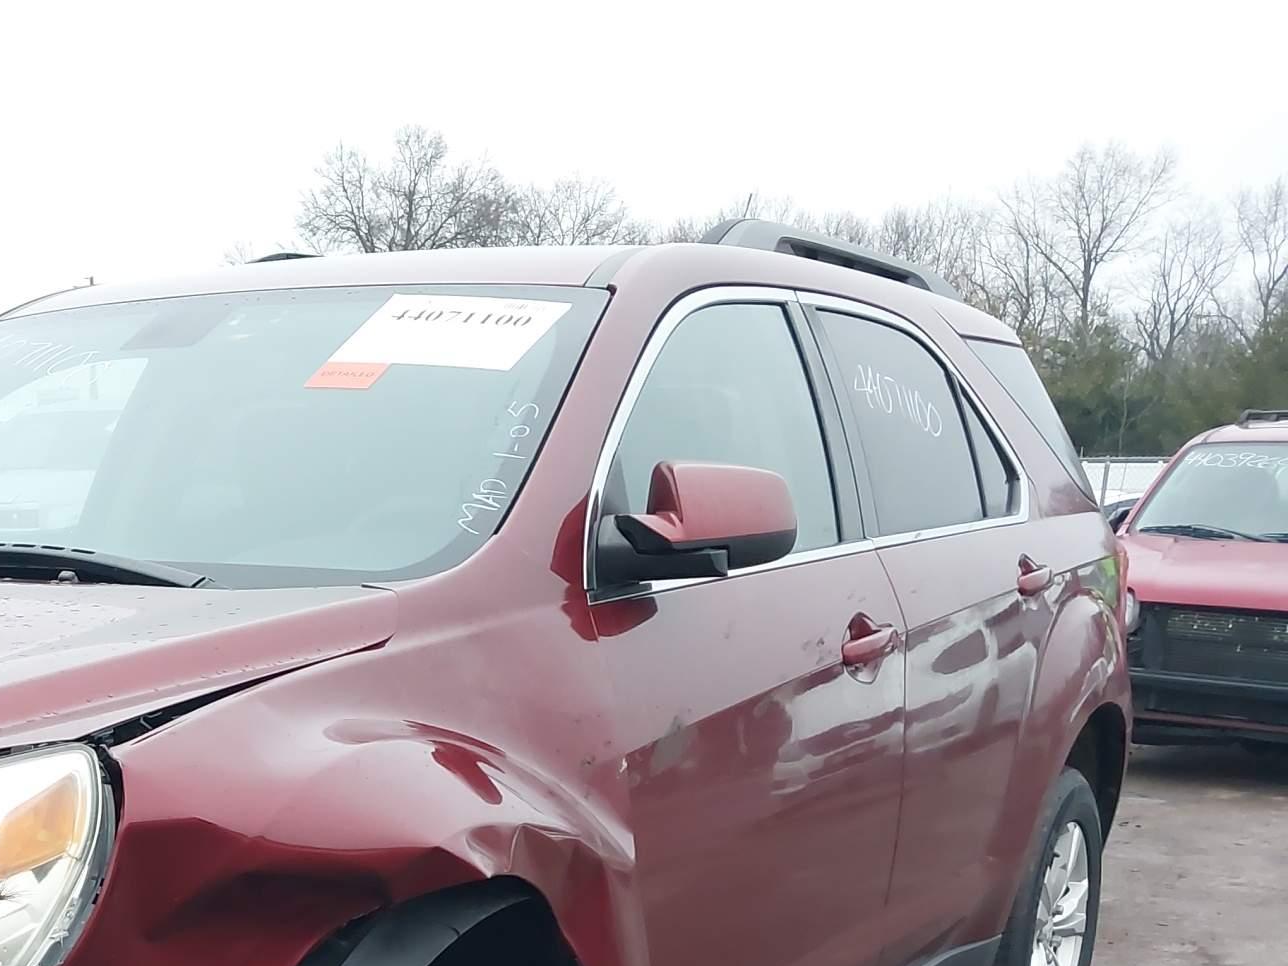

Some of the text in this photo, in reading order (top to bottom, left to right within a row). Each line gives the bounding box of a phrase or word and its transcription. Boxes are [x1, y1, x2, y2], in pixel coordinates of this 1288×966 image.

[392, 309, 533, 327] 44071100
[853, 364, 943, 437] 44071100
[457, 478, 508, 535] MAD
